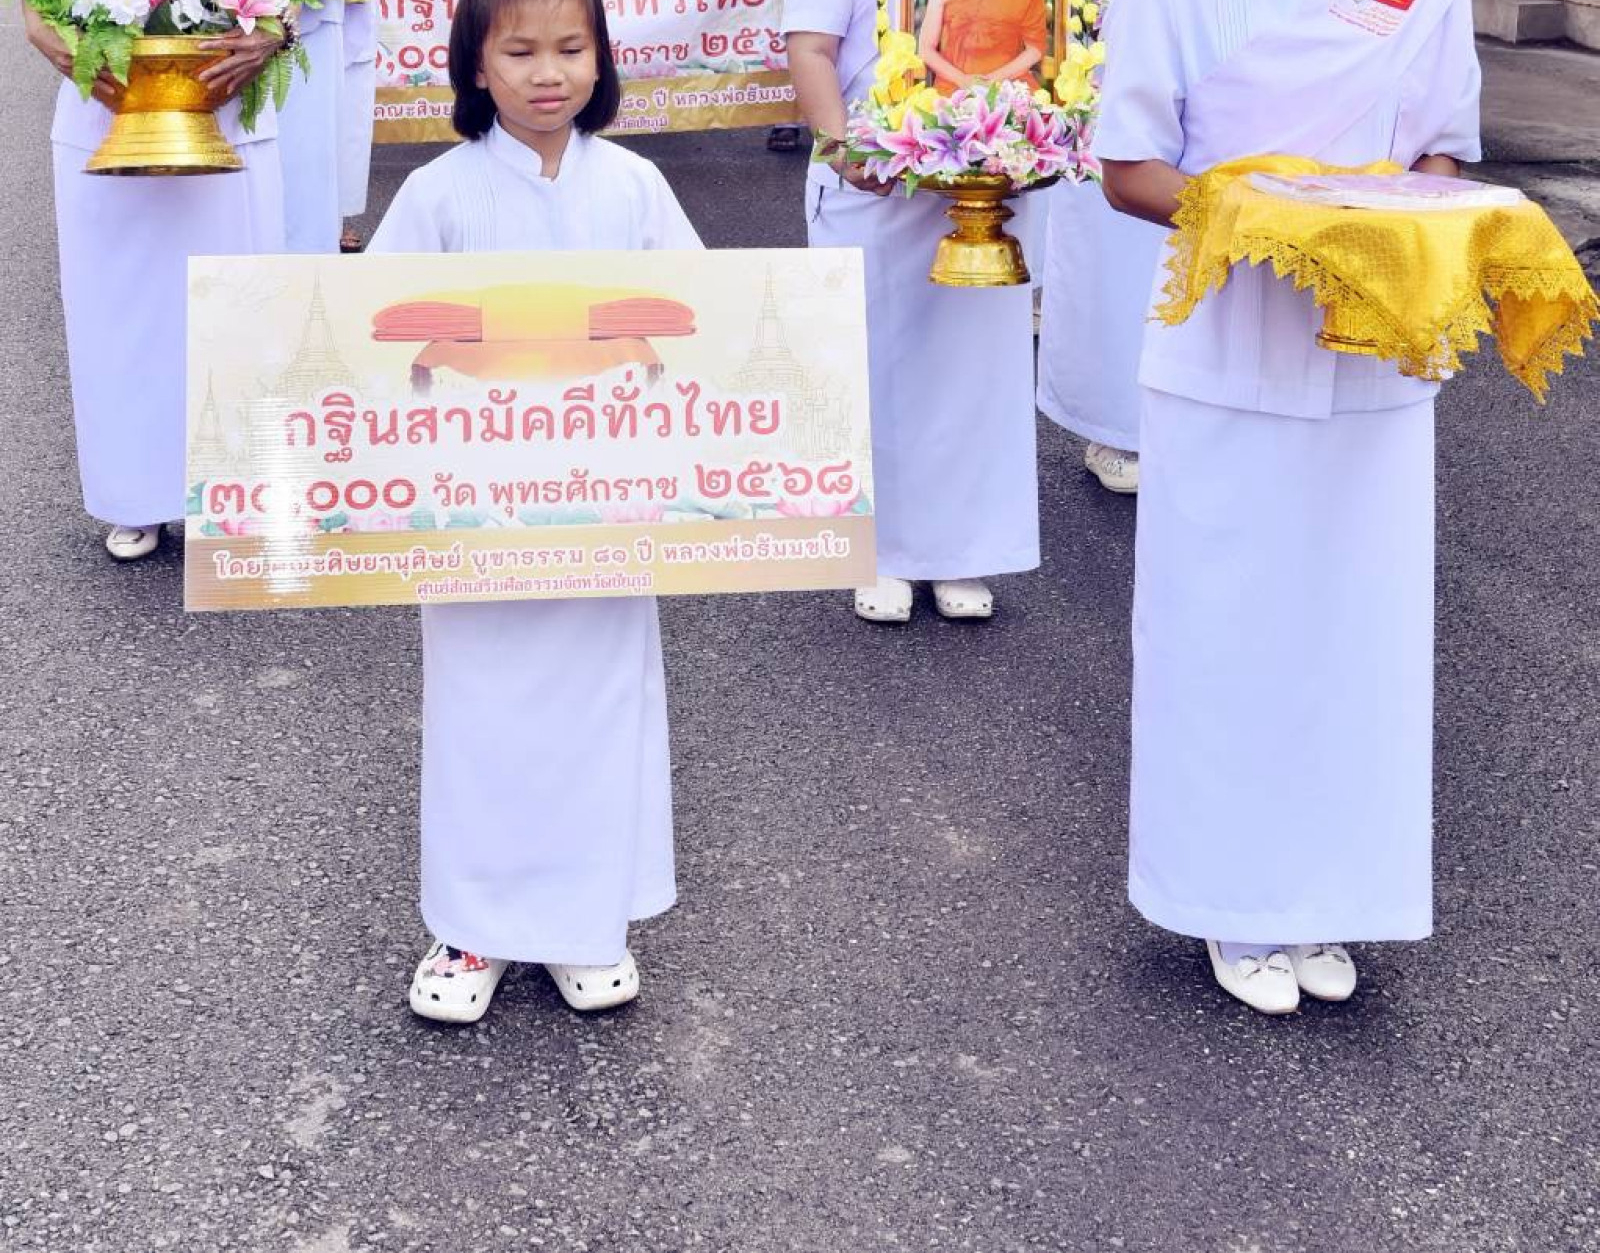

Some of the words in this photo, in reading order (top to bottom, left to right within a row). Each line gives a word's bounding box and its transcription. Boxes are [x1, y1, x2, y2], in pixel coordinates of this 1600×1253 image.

[284, 369, 780, 463] กฐินสามัคคีทั่วไทย
[209, 478, 417, 515] ๓๐๐๐
[433, 472, 477, 507] วัด
[488, 468, 679, 518] พุทธศักราช
[694, 460, 853, 498] ๒๕๖๘
[216, 544, 463, 576] โดยะศิษยานุศิษย์
[472, 548, 583, 574] บูชาธรรม
[637, 536, 653, 562] ปี
